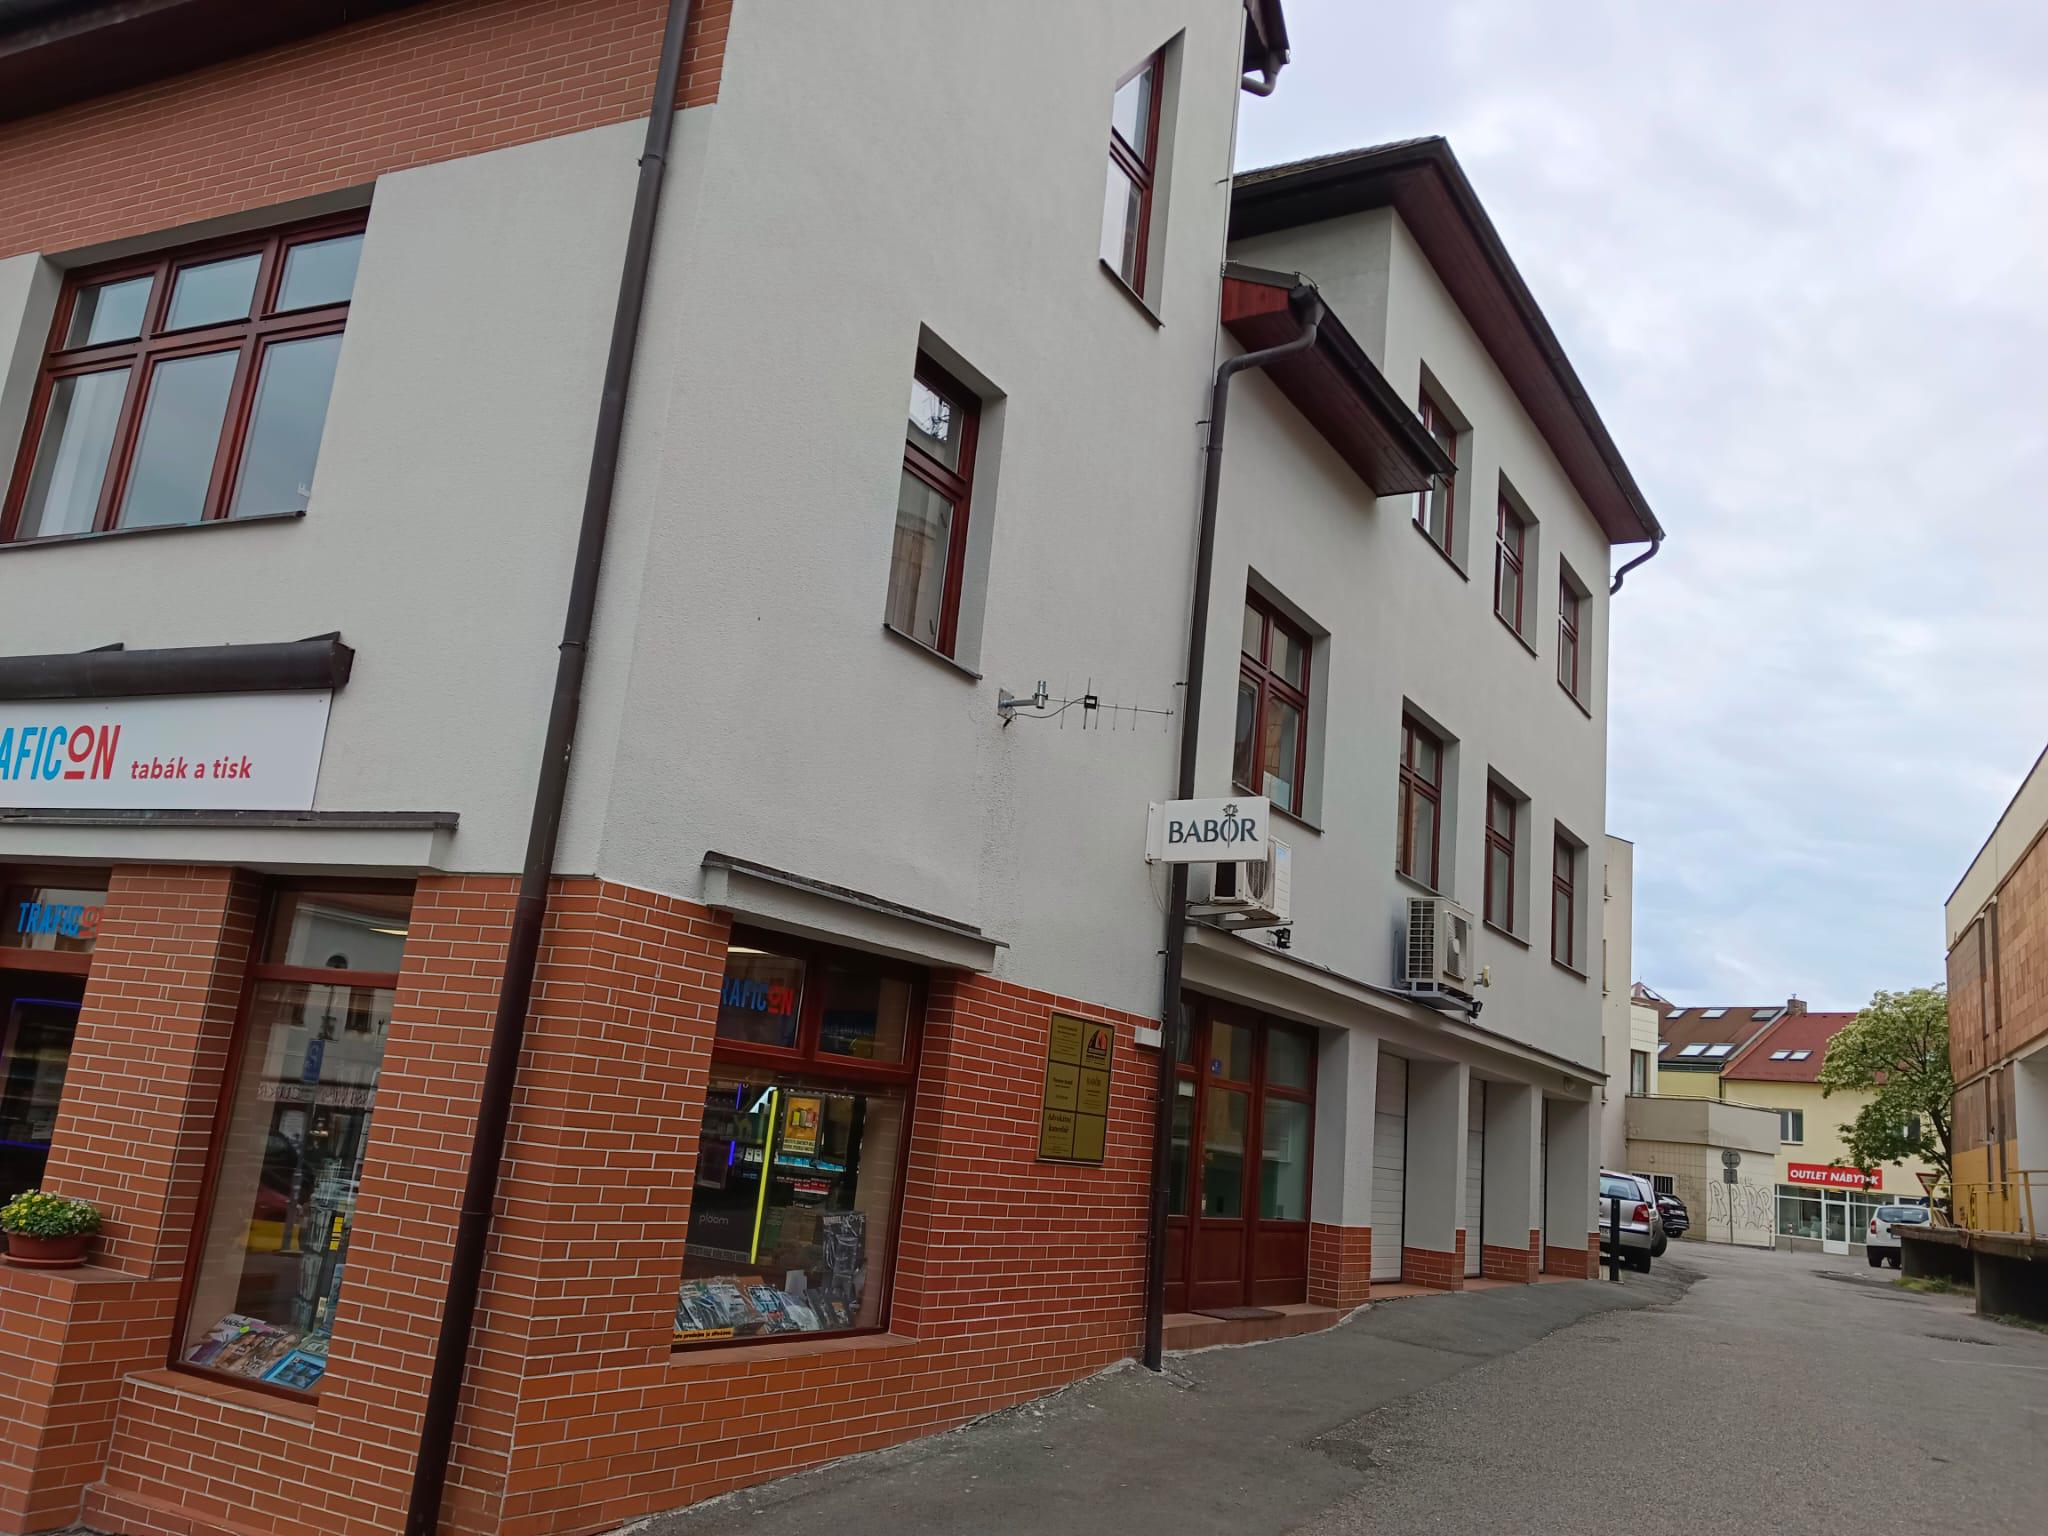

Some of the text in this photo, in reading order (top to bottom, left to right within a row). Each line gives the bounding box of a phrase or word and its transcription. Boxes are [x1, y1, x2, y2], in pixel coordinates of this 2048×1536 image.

[131, 757, 188, 779] tabák
[193, 763, 205, 779] a
[213, 755, 252, 779] tisk
[1168, 818, 1259, 844] BABOR
[17, 902, 98, 938] TRAFICO
[1790, 1169, 1879, 1184] OUTLET NÁBYTK
